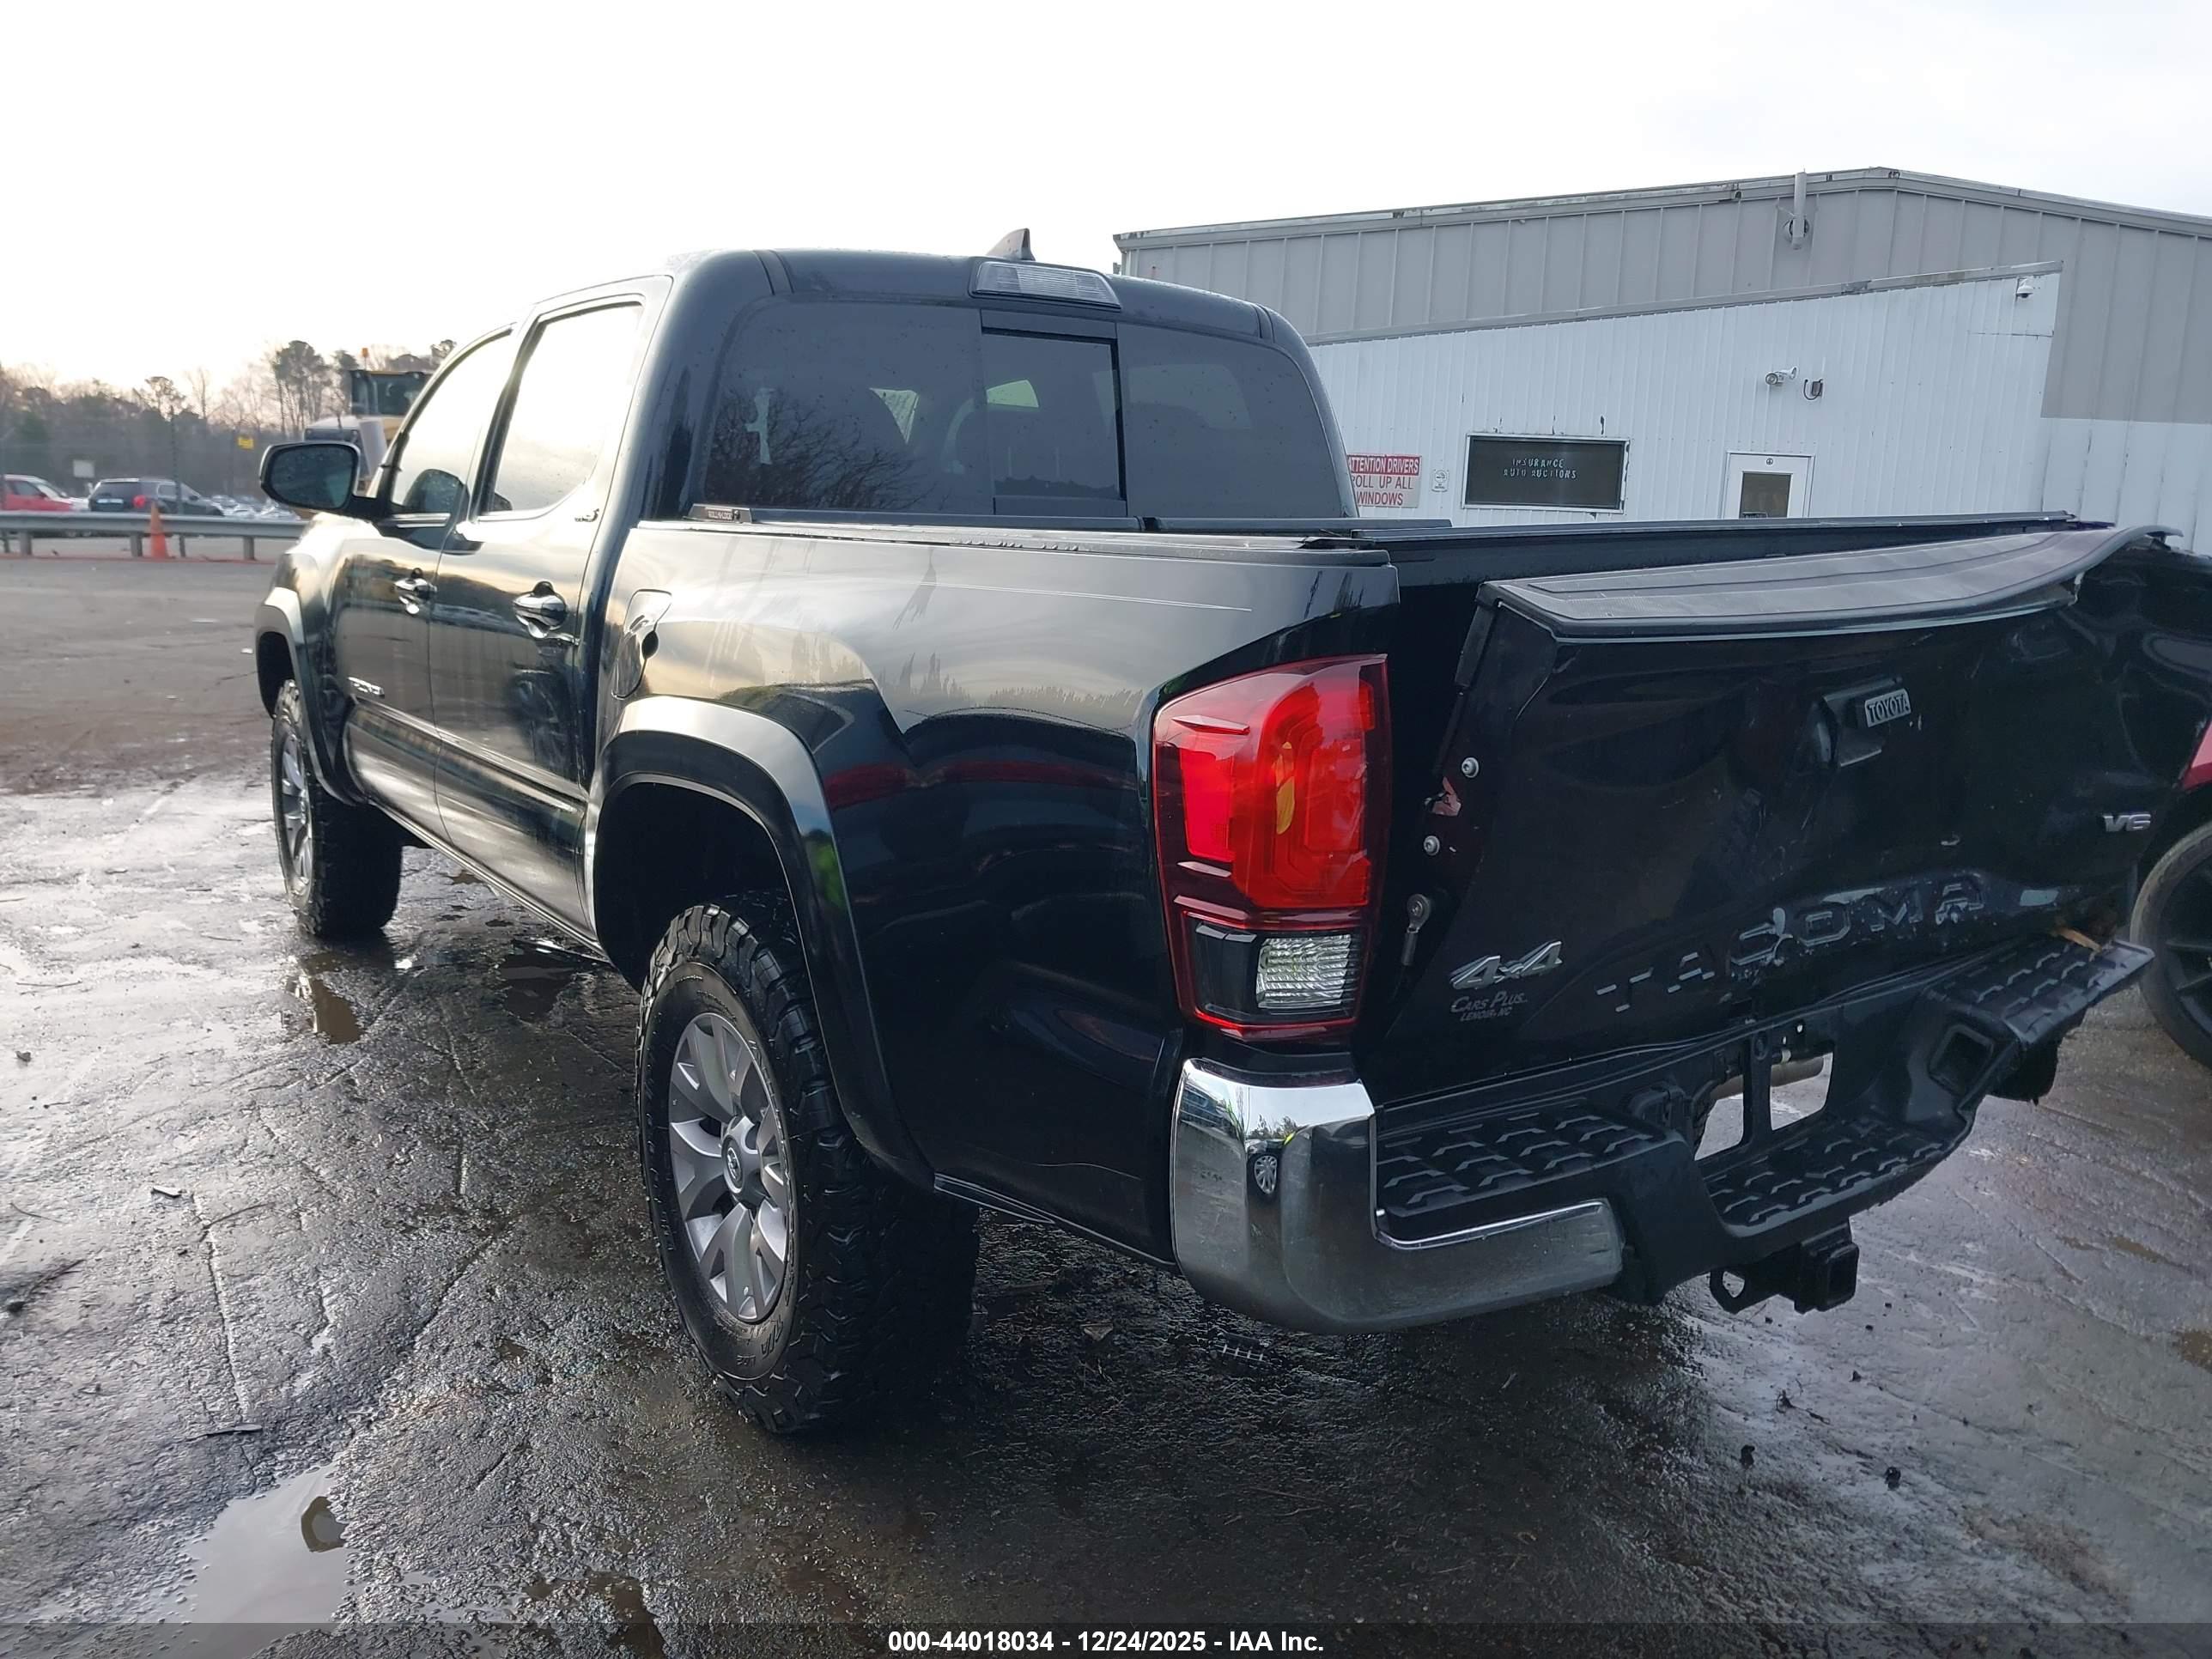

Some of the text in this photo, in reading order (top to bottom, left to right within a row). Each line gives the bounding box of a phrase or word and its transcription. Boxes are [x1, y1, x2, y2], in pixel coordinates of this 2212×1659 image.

[1387, 458, 1419, 474] DRIVERS
[1379, 476, 1392, 489] UP
[1395, 477, 1414, 489] ALL
[1356, 491, 1404, 506] WINDOWS
[1867, 694, 1911, 723] TOYOTA
[2102, 812, 2151, 832] V6
